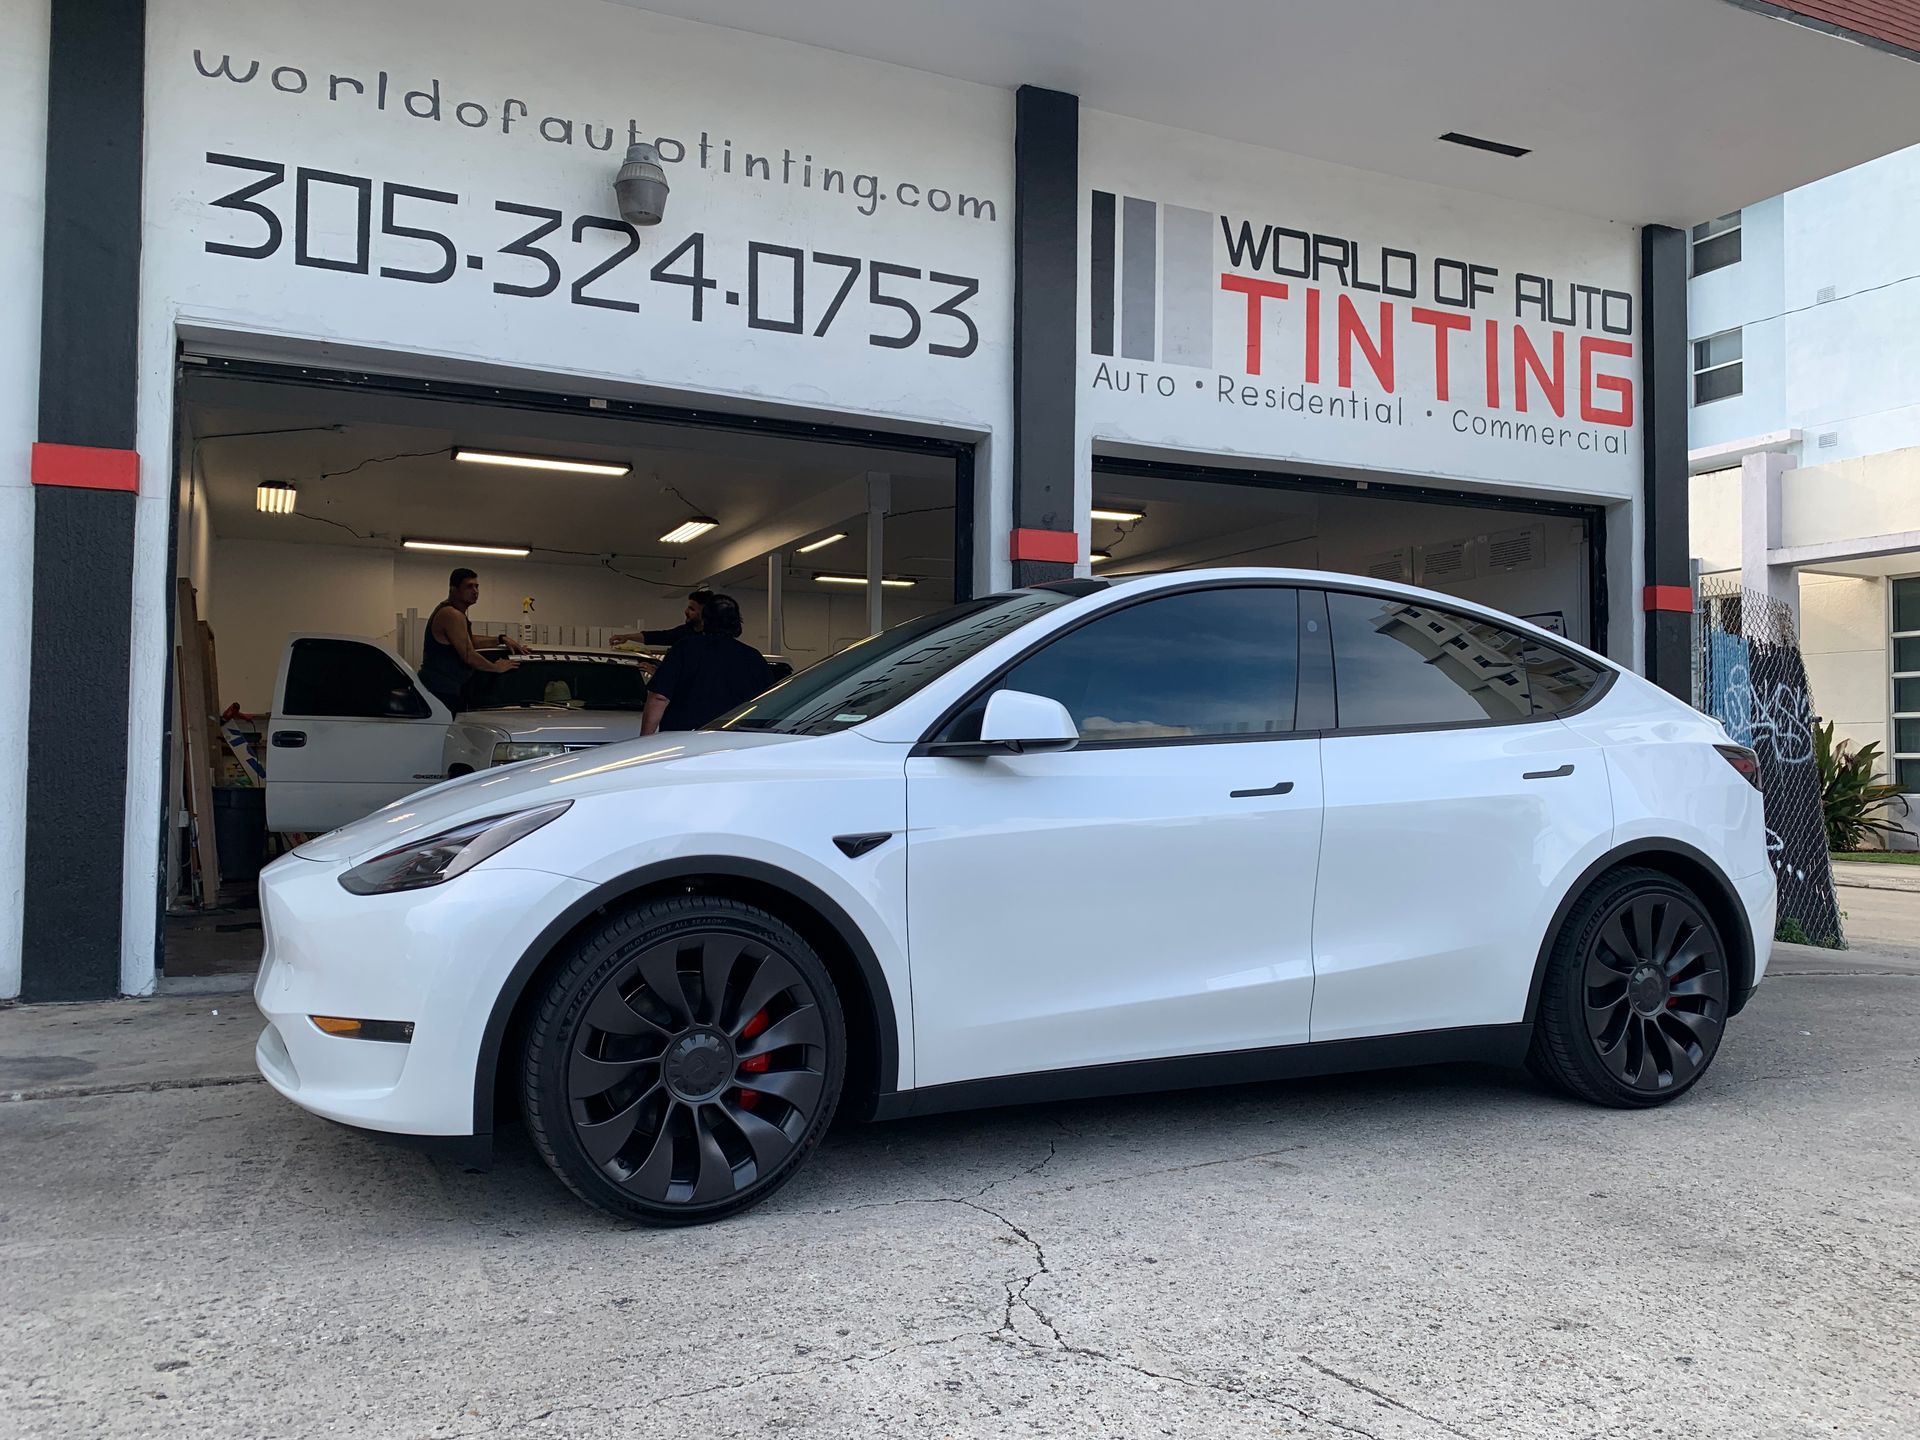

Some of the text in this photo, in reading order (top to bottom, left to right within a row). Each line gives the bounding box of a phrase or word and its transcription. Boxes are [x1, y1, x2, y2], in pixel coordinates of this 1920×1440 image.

[193, 49, 996, 222] worldofautotinting.com
[204, 151, 980, 359] 305.324.0753
[1220, 214, 1633, 336] WORLD OF AUTO
[1218, 375, 1403, 426] Residential
[1452, 408, 1629, 456] Commercial
[1220, 273, 1634, 428] TINTING
